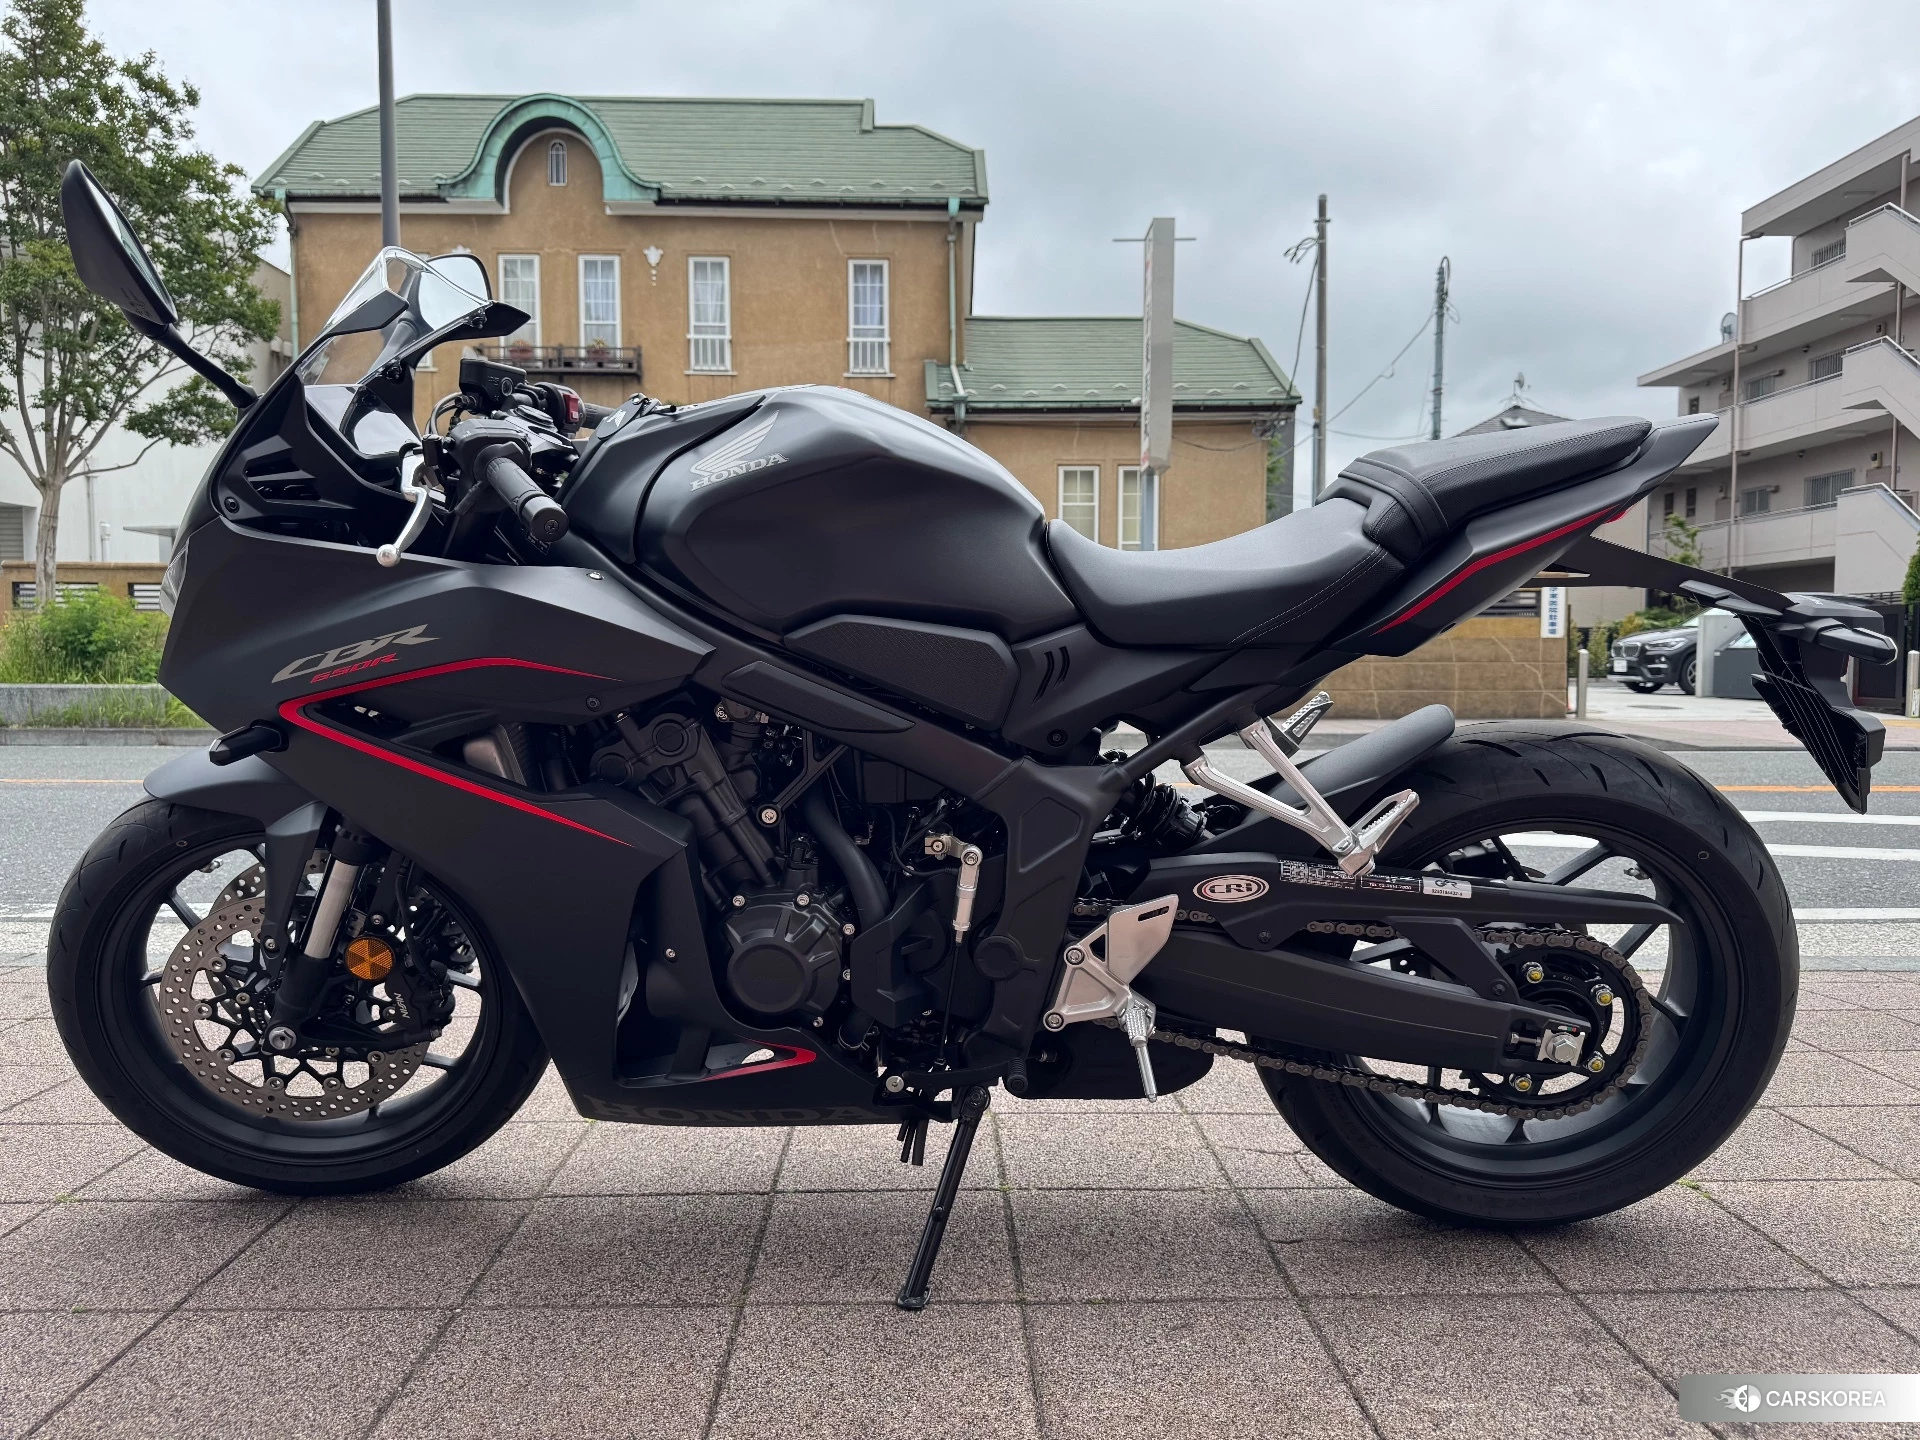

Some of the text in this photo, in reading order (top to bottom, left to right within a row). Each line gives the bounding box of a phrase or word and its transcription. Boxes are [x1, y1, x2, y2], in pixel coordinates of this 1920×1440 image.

[690, 453, 789, 492] HONDA
[271, 623, 440, 683] CBR
[310, 652, 399, 683] 650R
[393, 992, 411, 1019] NISSIN
[583, 1094, 889, 1123] HONDA
